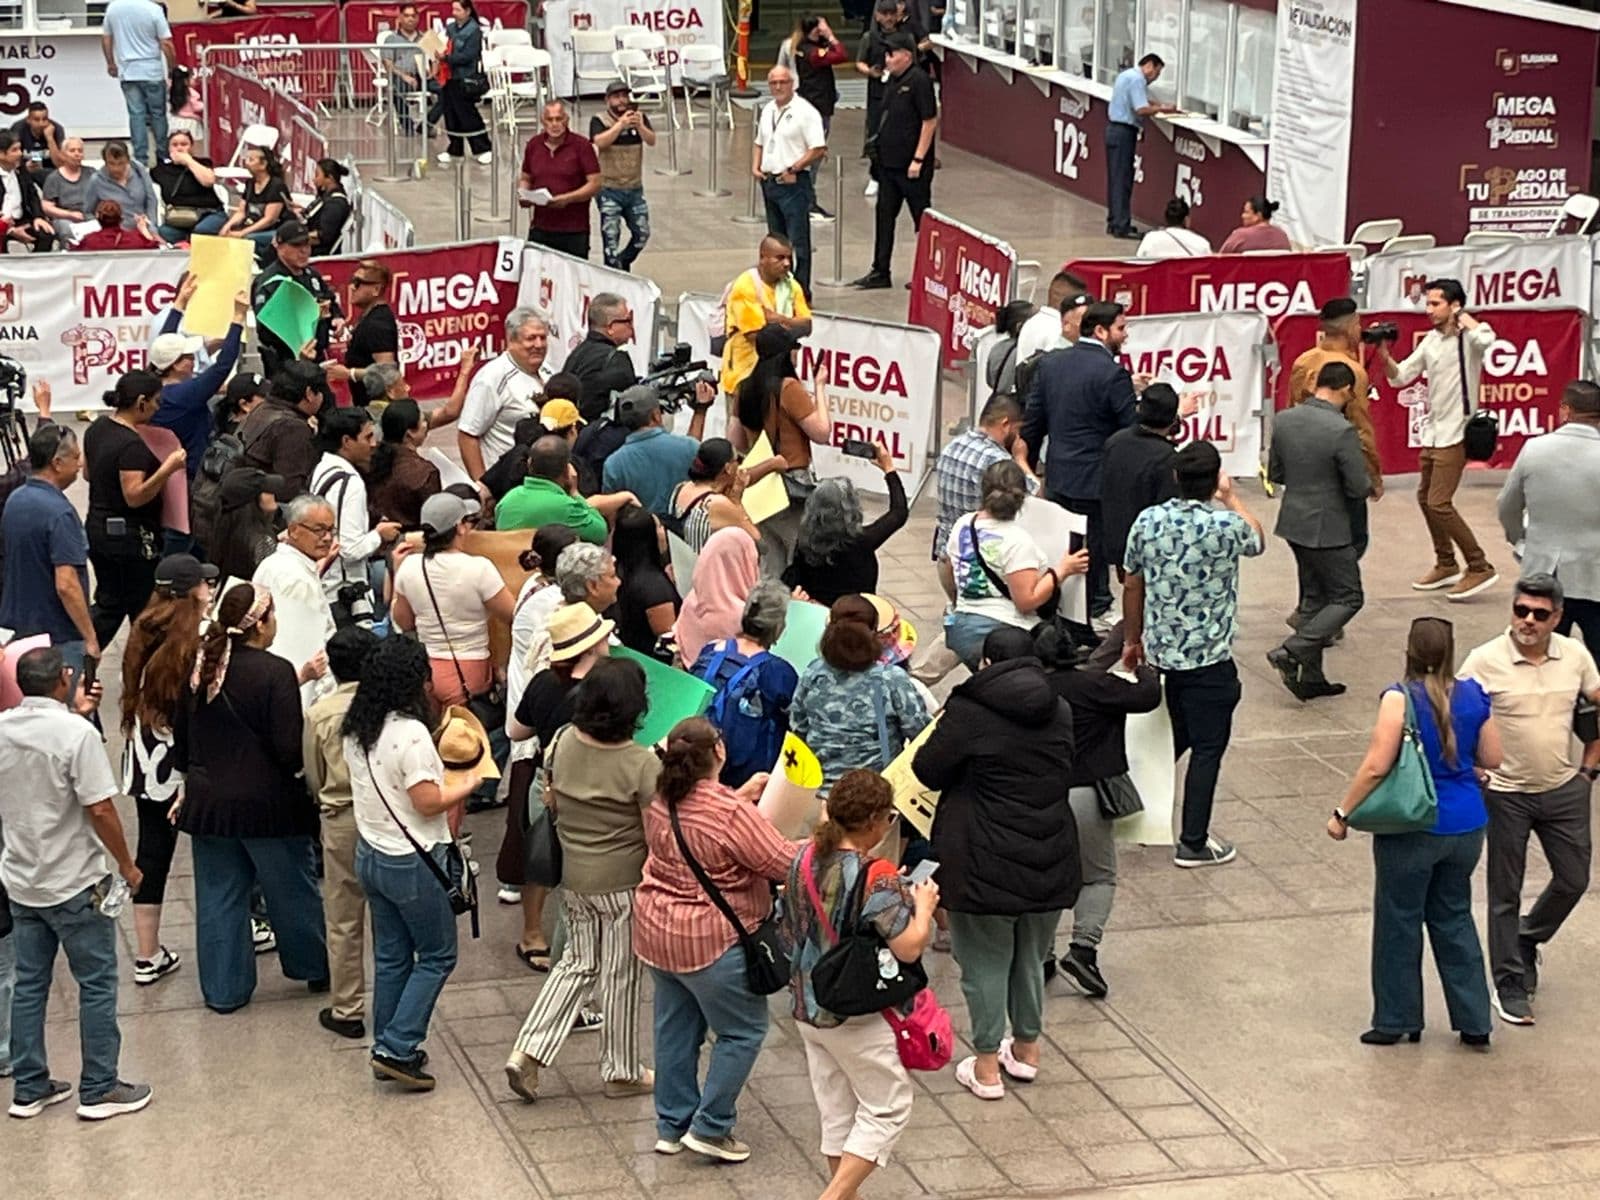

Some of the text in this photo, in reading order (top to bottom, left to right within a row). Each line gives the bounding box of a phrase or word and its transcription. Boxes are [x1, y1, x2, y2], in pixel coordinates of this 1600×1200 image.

[630, 8, 703, 31] MEGA
[1497, 96, 1557, 116] MEGA
[1549, 168, 1567, 181] DE
[1466, 183, 1490, 201] TU
[501, 251, 513, 272] 5
[399, 271, 499, 316] MEGA
[960, 256, 1001, 310] MEGA
[1474, 266, 1562, 305] MEGA
[83, 282, 177, 319] MEG
[1199, 280, 1318, 317] MEGA
[424, 312, 489, 338] EVENTO
[800, 346, 909, 399] MEGA
[828, 394, 894, 423] EVENTO
